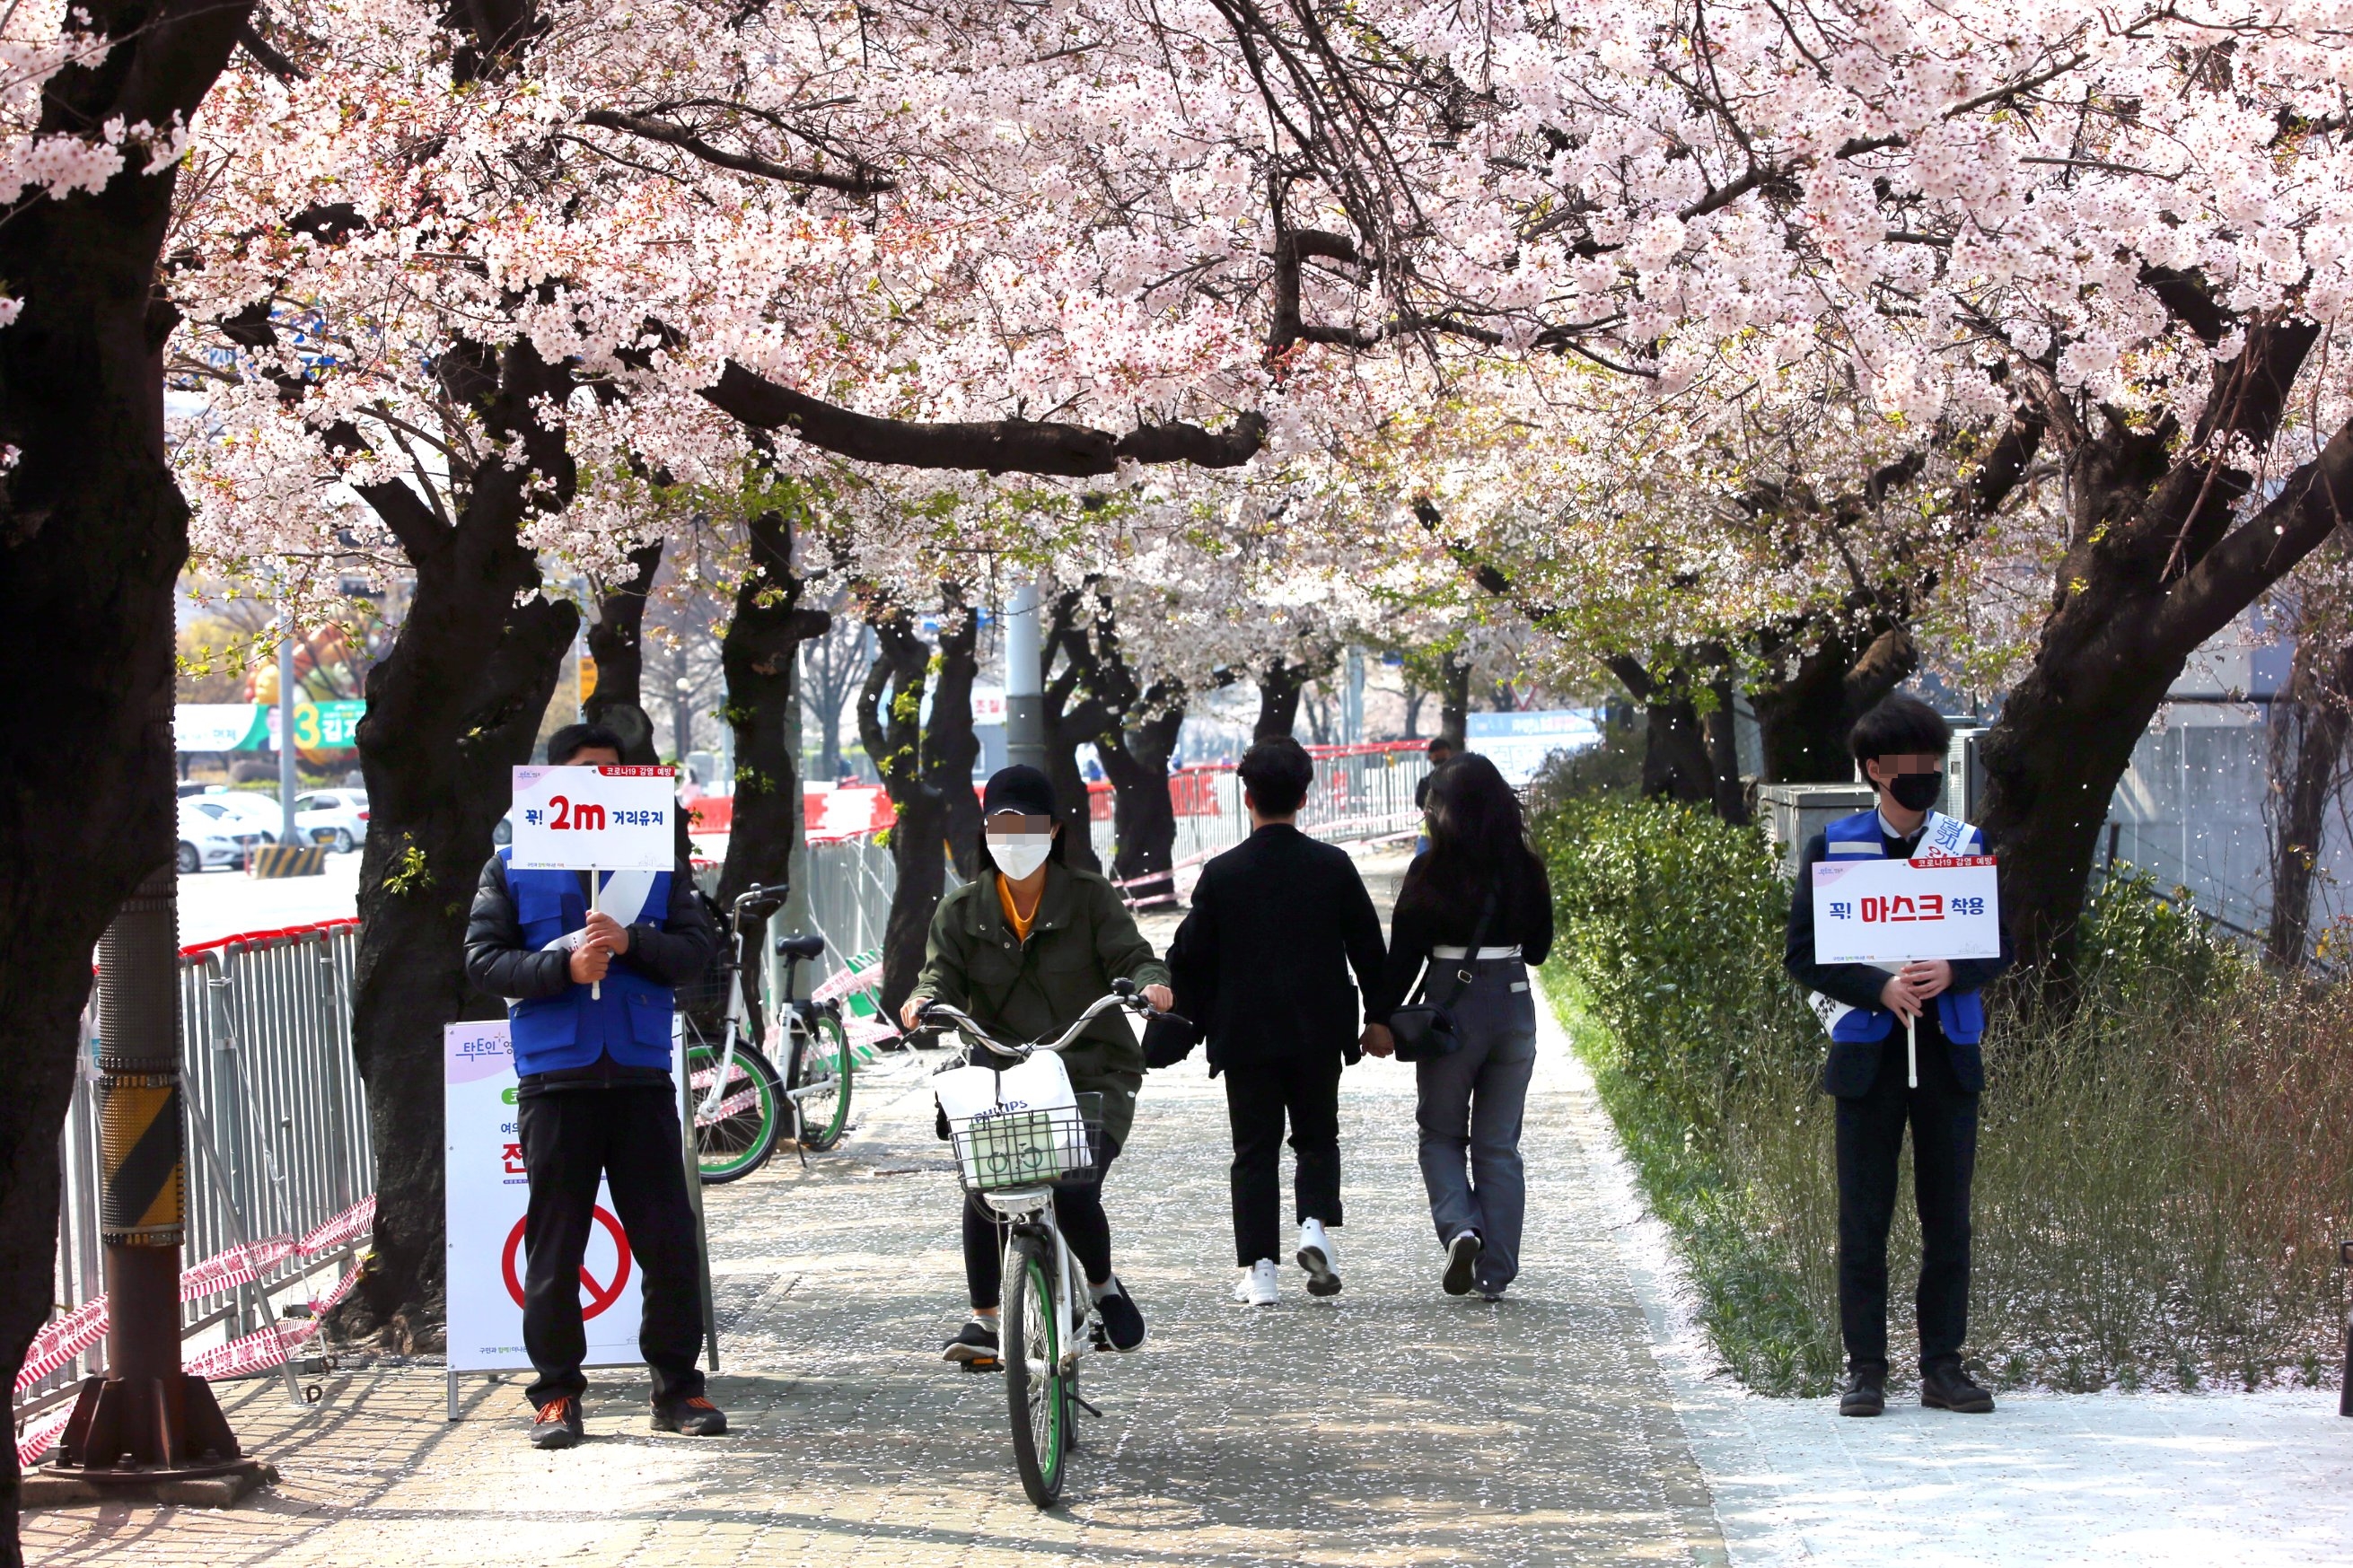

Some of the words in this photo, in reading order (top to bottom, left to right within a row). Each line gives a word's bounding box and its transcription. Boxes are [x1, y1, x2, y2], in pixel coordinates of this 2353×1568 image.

[293, 703, 320, 749] 3
[606, 766, 637, 776] 코로나19
[639, 766, 654, 776] 감염
[657, 766, 672, 776] 예방
[525, 810, 543, 826] 꼭!
[549, 795, 606, 830] 2m
[612, 810, 663, 826] 거리유지
[1918, 859, 1952, 867] 코로나19
[1955, 857, 1972, 867] 감염
[1976, 856, 1992, 865] 예방
[1829, 902, 1851, 920] 꼭!
[1860, 894, 1945, 923] 마스크
[1951, 897, 1985, 915] 착용
[455, 1038, 504, 1062] 탁트인
